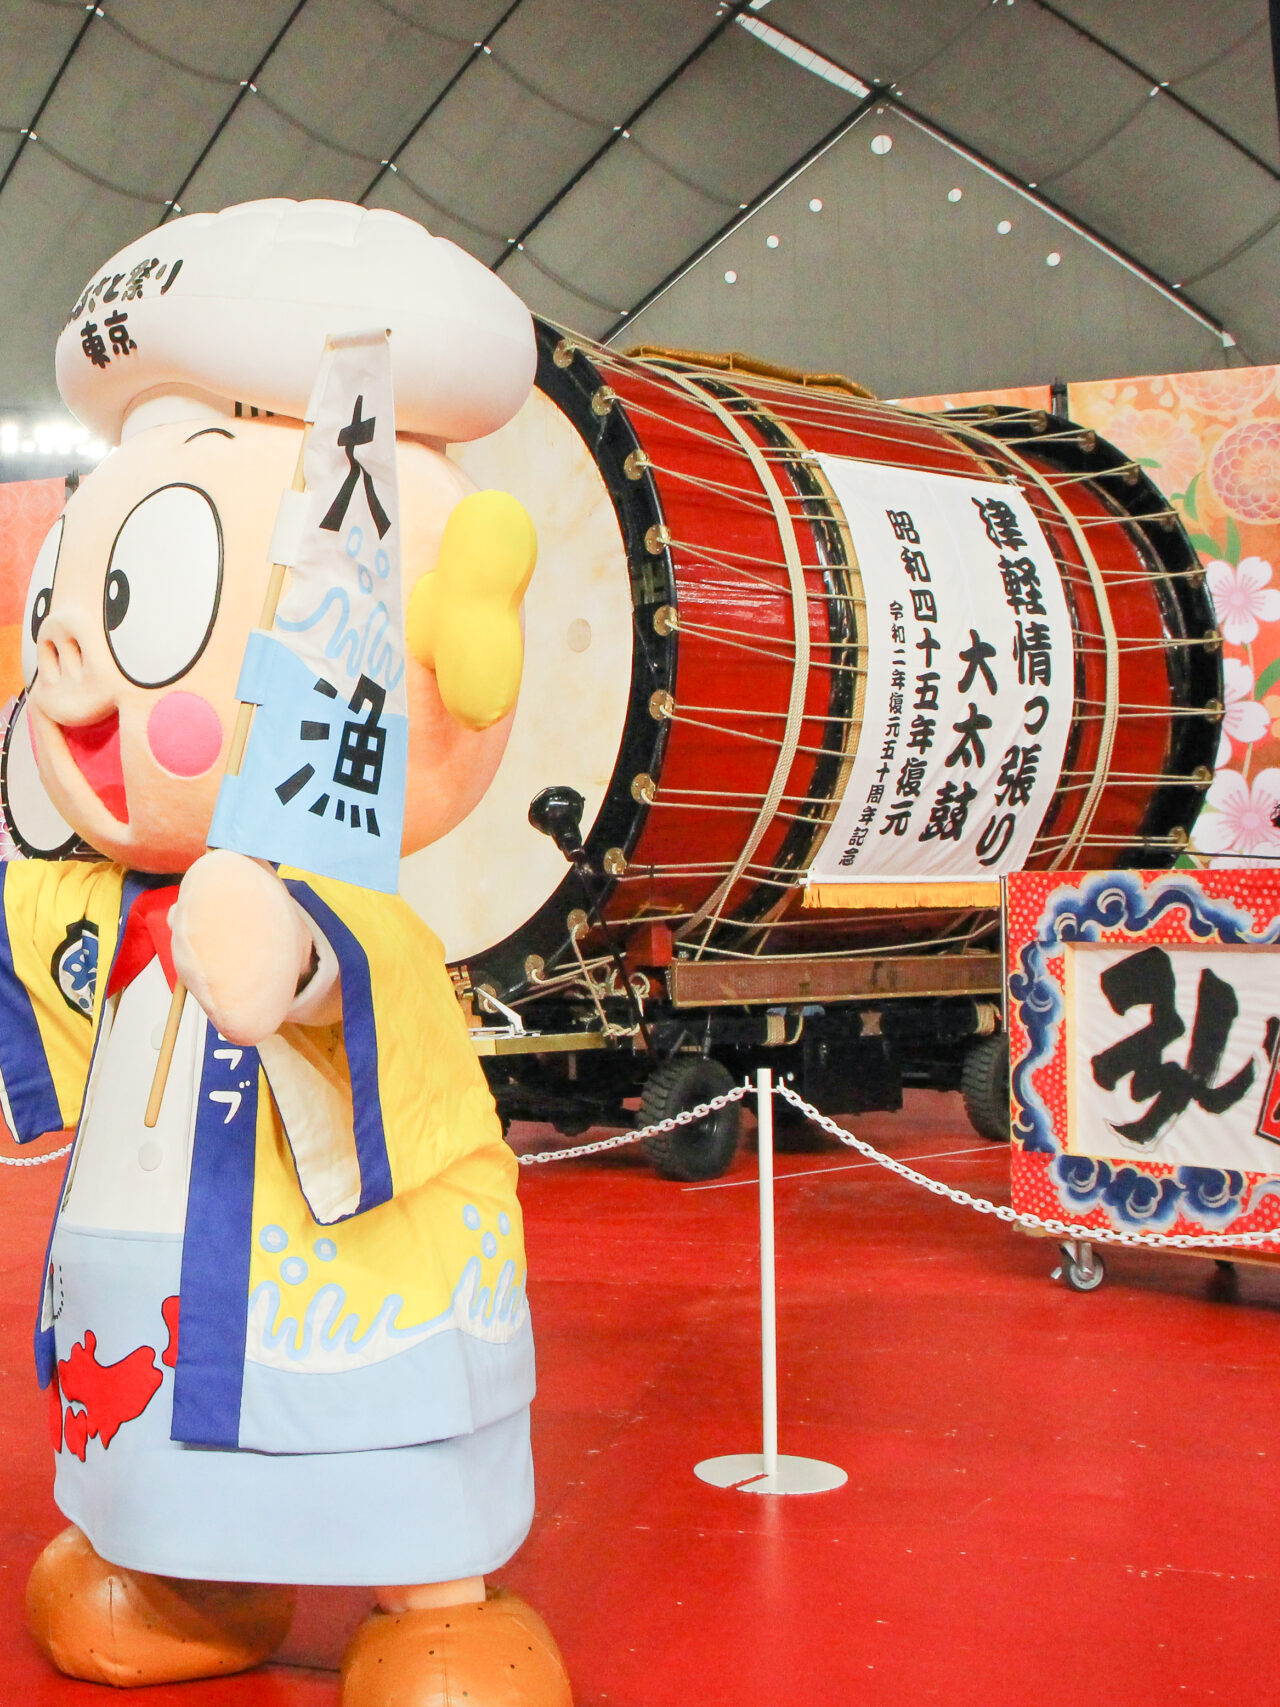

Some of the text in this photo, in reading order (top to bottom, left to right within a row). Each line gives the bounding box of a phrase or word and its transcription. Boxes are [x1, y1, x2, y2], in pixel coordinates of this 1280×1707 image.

[81, 310, 137, 368] 東京
[275, 395, 391, 837] 大漁
[838, 600, 907, 866] 令和二年復元五十周年記念
[880, 509, 941, 836] 昭和四十五年復元
[919, 629, 998, 842] 大太鼓
[971, 497, 1052, 866] 津軽情っ張り
